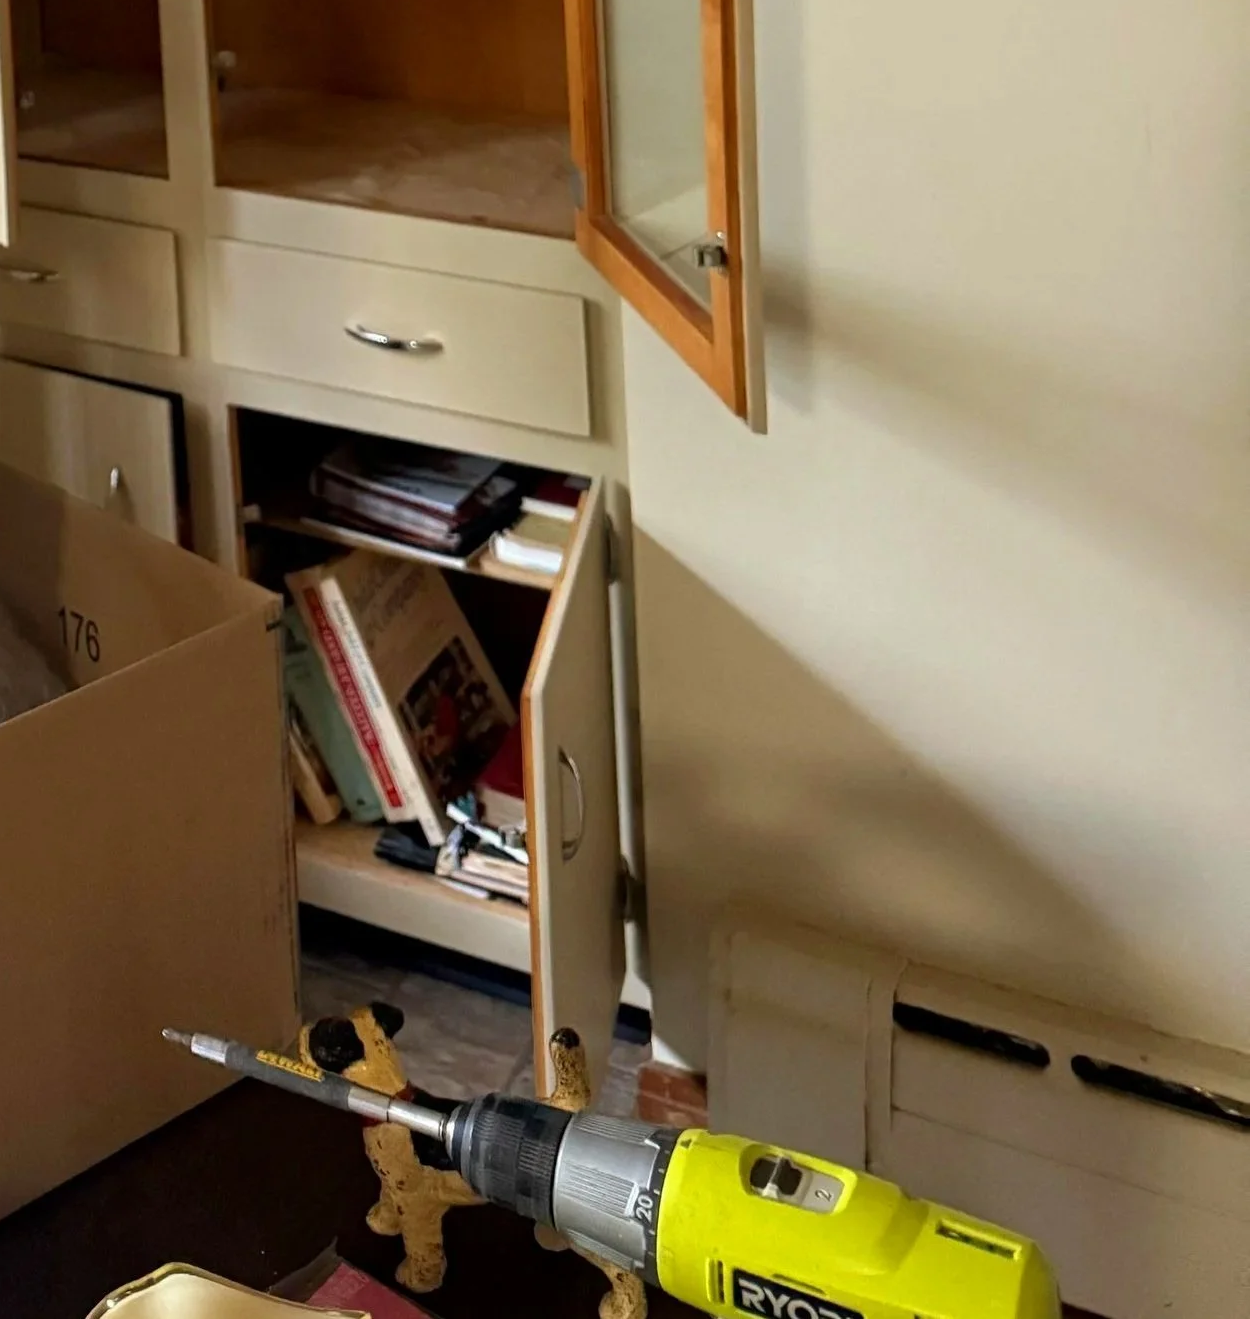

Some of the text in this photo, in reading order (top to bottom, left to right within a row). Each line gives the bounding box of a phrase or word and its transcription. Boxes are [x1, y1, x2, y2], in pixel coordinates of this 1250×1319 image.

[58, 606, 100, 662] 176
[635, 1194, 654, 1223] 20
[815, 1188, 833, 1203] 2
[738, 1279, 853, 1319] RYO
